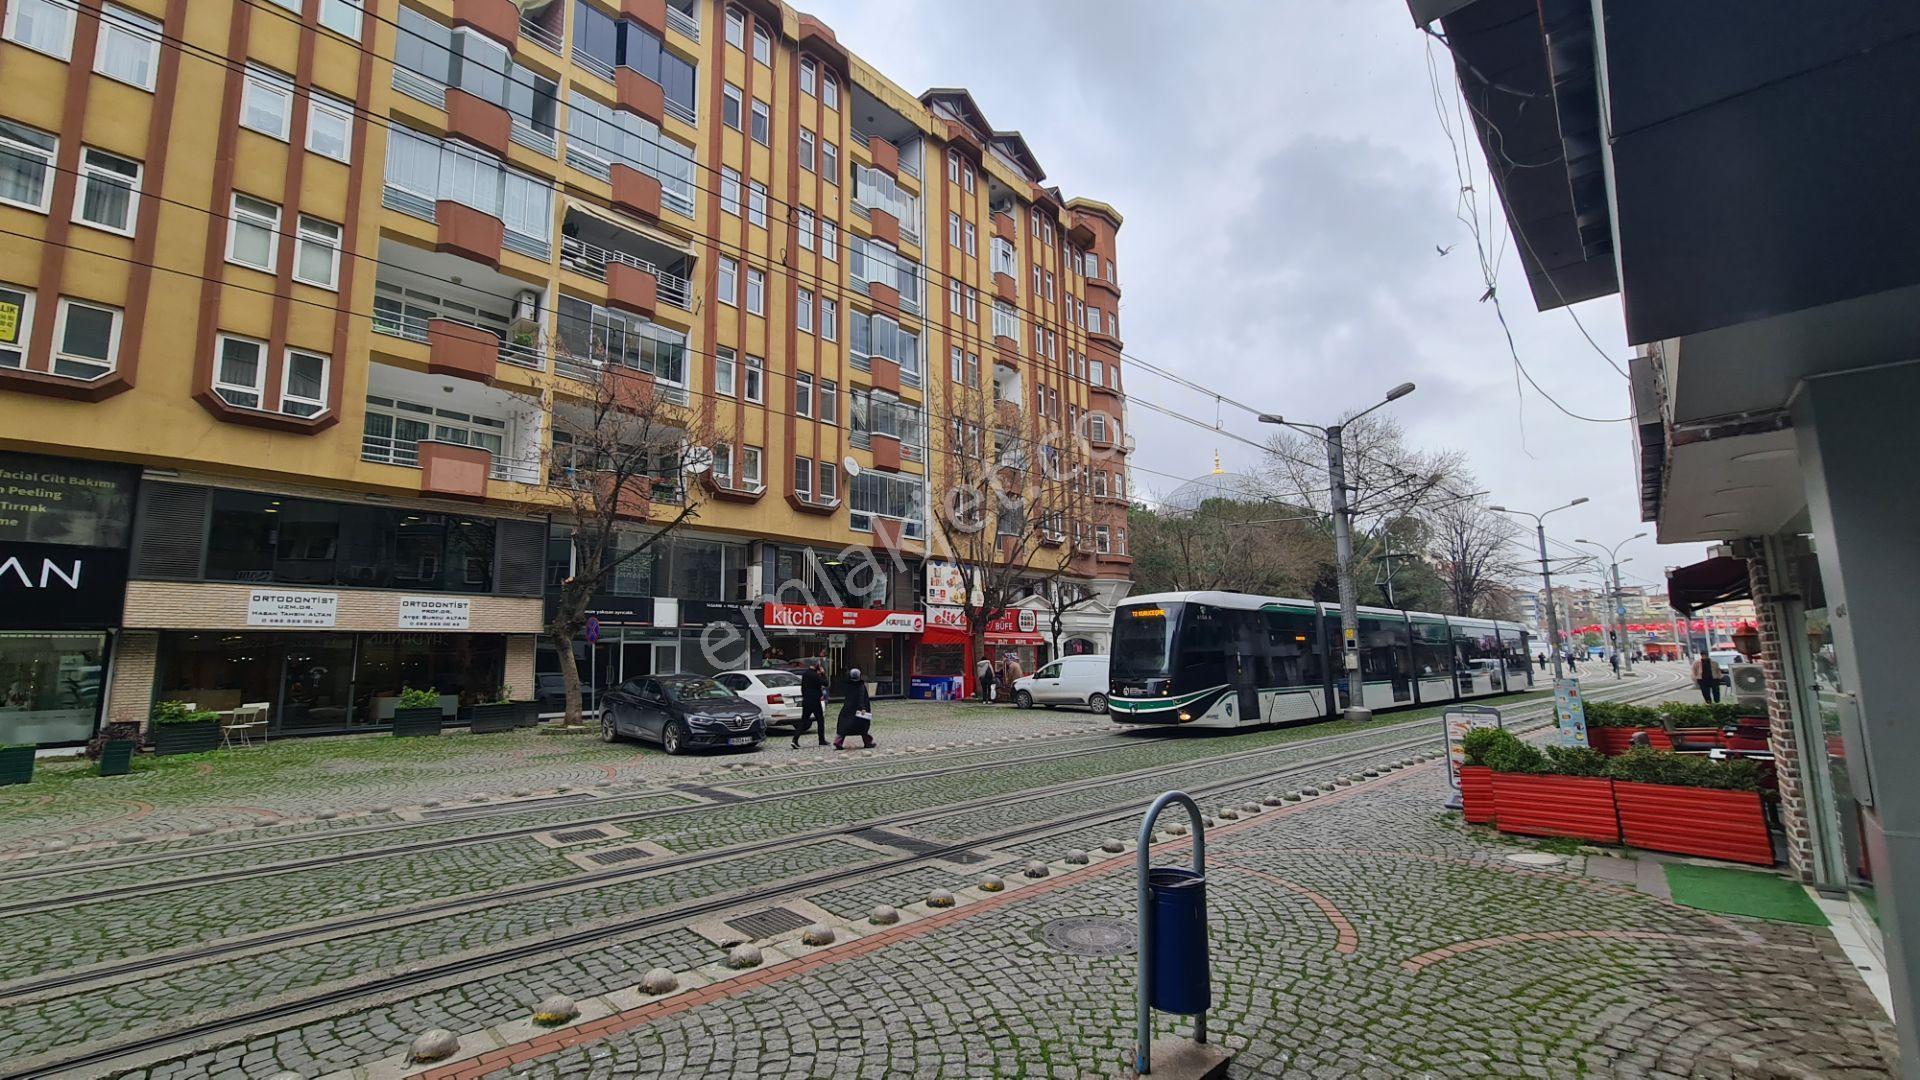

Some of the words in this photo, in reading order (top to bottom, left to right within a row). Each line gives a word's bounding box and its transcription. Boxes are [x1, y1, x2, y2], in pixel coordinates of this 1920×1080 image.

[41, 474, 65, 484] Cilt
[69, 476, 116, 489] Bakımı
[9, 486, 62, 500] Peeling
[1, 501, 47, 513] Tırnak
[772, 606, 823, 626] kitche
[995, 621, 1013, 631] BÜFE
